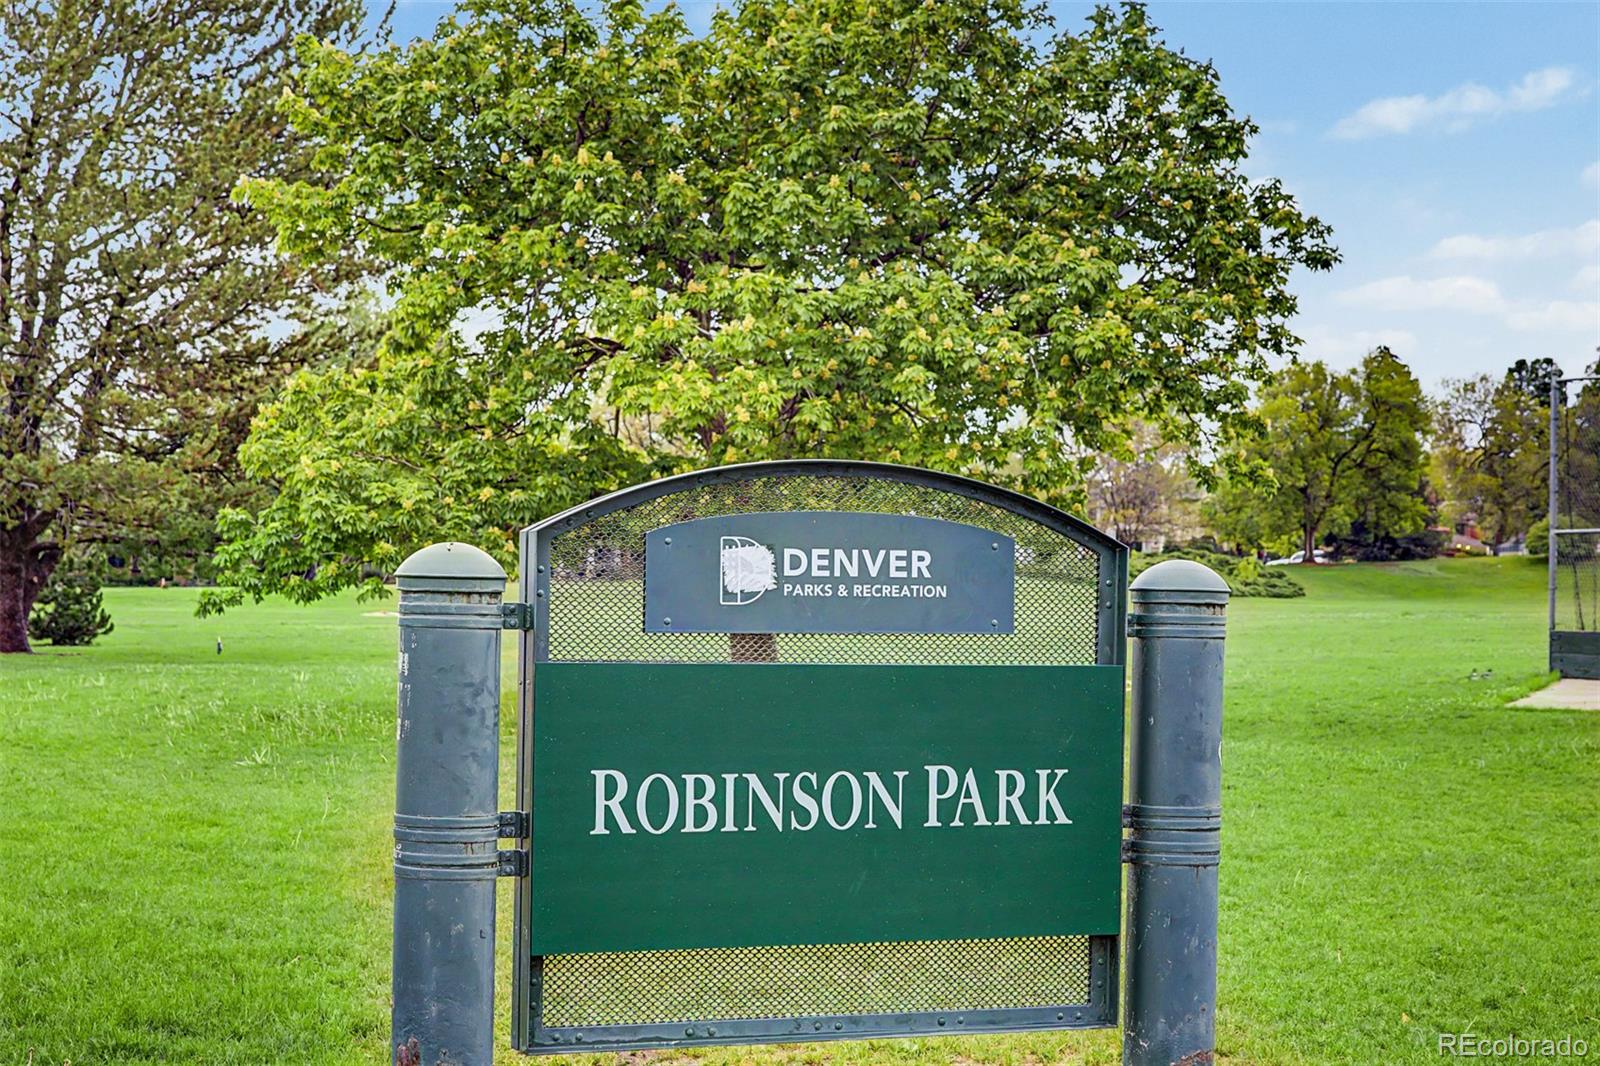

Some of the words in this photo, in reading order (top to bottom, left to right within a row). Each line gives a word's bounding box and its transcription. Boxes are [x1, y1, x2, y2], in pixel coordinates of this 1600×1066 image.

[783, 547, 932, 579] DENVER
[783, 583, 833, 598] PARKS
[838, 584, 849, 598] &
[853, 585, 948, 599] RECREATION
[589, 769, 910, 836] ROBINSON
[923, 764, 1073, 828] PARK
